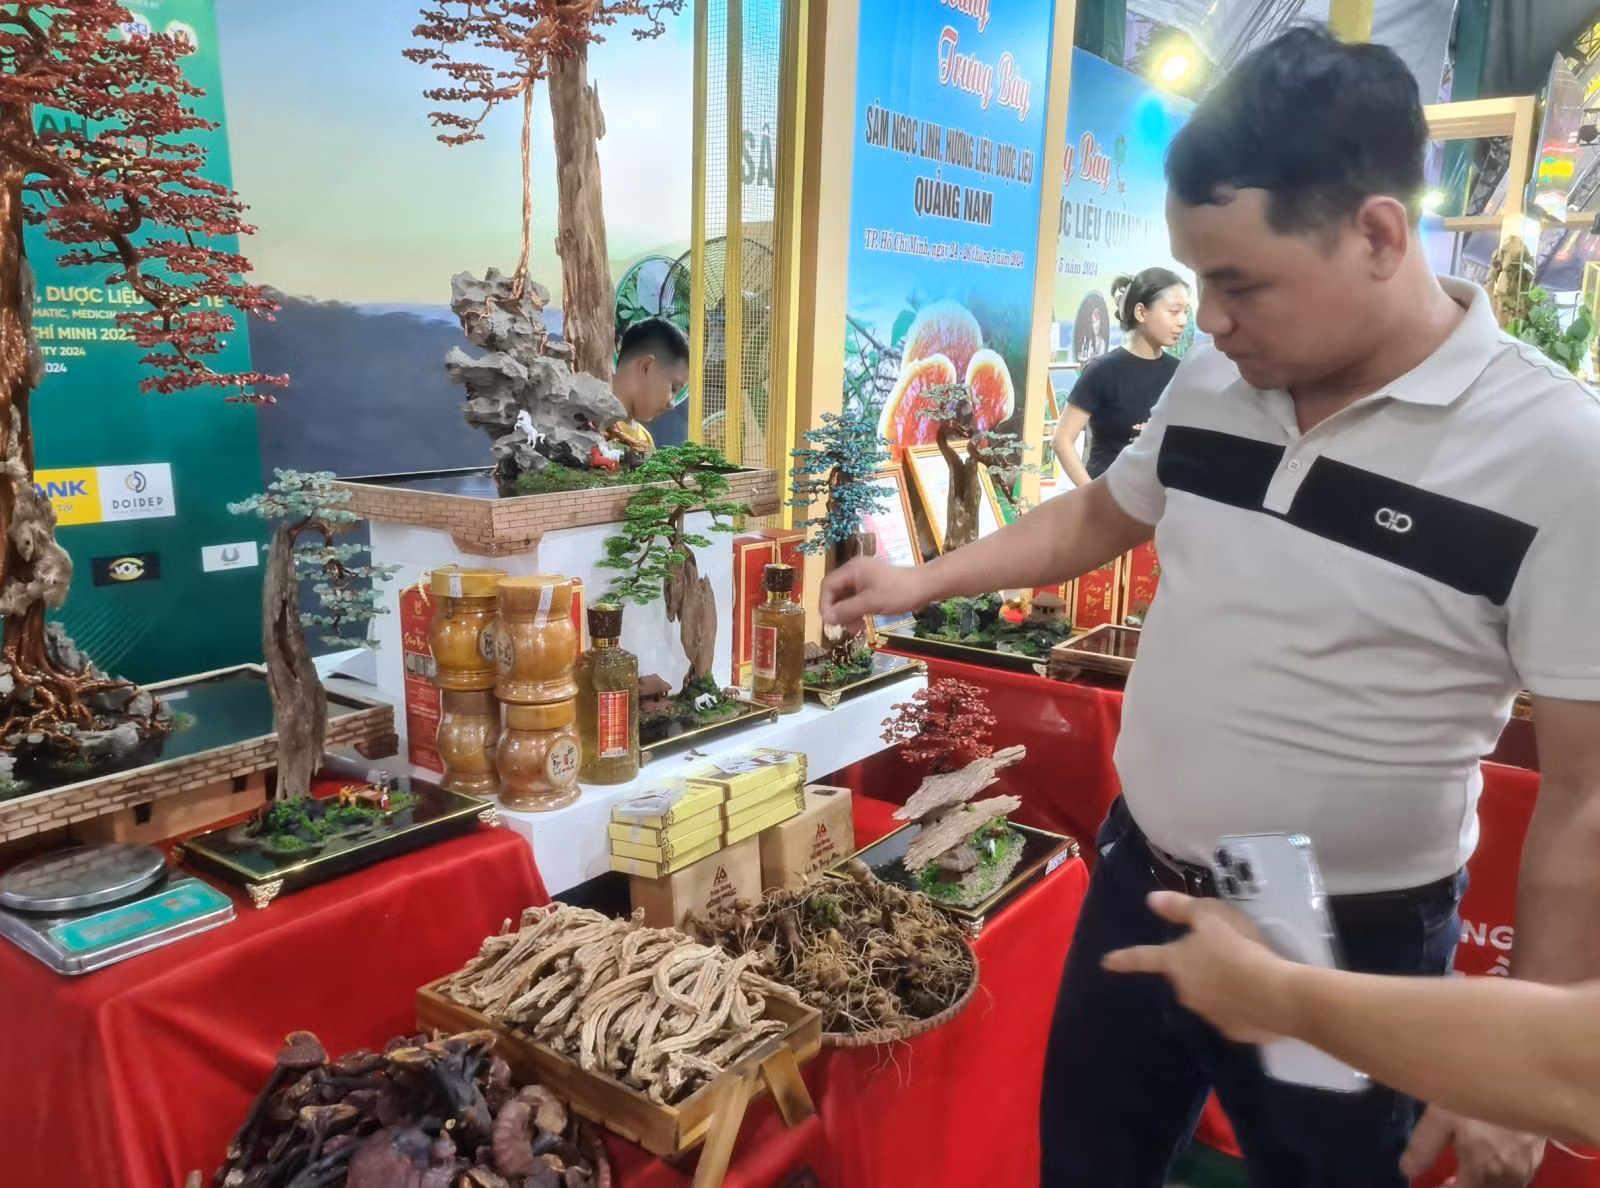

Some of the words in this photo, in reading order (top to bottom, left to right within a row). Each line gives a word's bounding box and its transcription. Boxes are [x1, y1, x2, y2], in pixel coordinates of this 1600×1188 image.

[865, 99, 889, 148] SÂM
[891, 112, 918, 163] NGỌC
[914, 169, 961, 219] QUẢNG
[963, 187, 993, 226] NAM
[46, 286, 104, 307] DƯỢC
[58, 327, 97, 340] MINH
[59, 346, 86, 357] 2024
